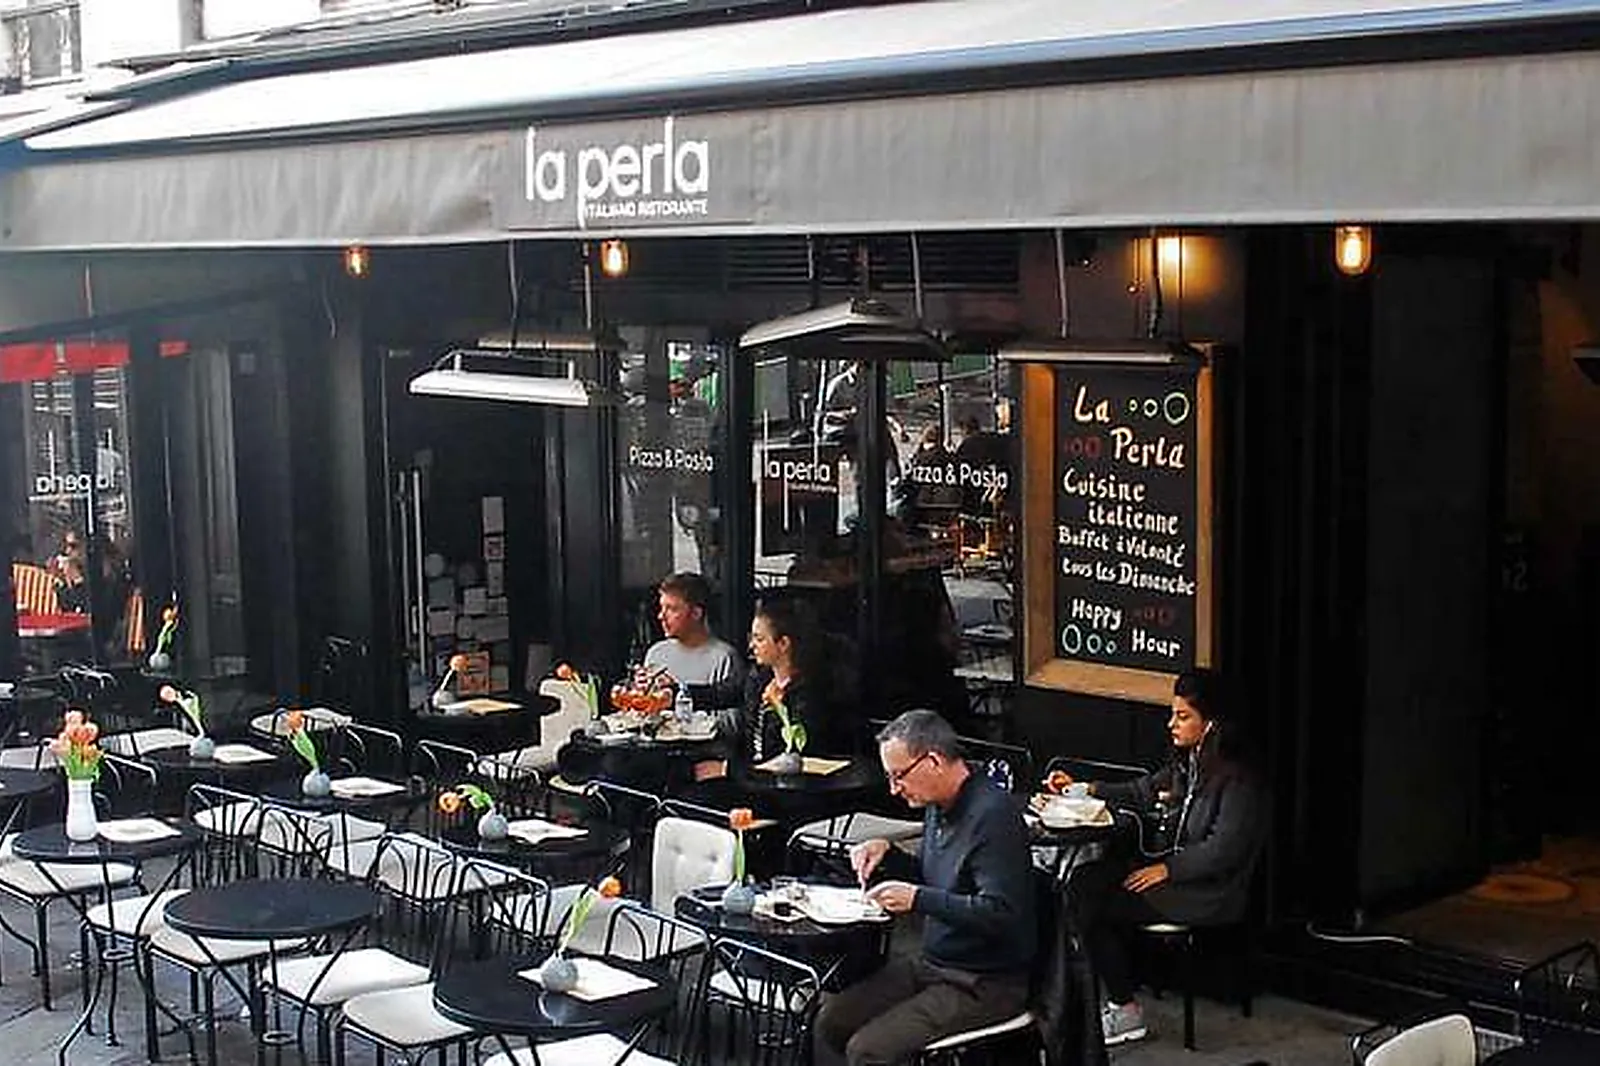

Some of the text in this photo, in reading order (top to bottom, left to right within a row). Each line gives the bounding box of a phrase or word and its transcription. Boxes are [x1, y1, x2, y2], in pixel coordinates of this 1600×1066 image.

[525, 115, 709, 229] la perla
[1074, 385, 1111, 423] La
[629, 445, 663, 468] Pizza
[762, 408, 781, 478] la
[1110, 426, 1186, 470] Perla
[902, 453, 1008, 489] Pizza & Pasta
[1063, 467, 1146, 501] Cuisine
[1088, 501, 1179, 535] italienne
[1071, 598, 1122, 630] Happy
[1131, 628, 1181, 658] Hour
